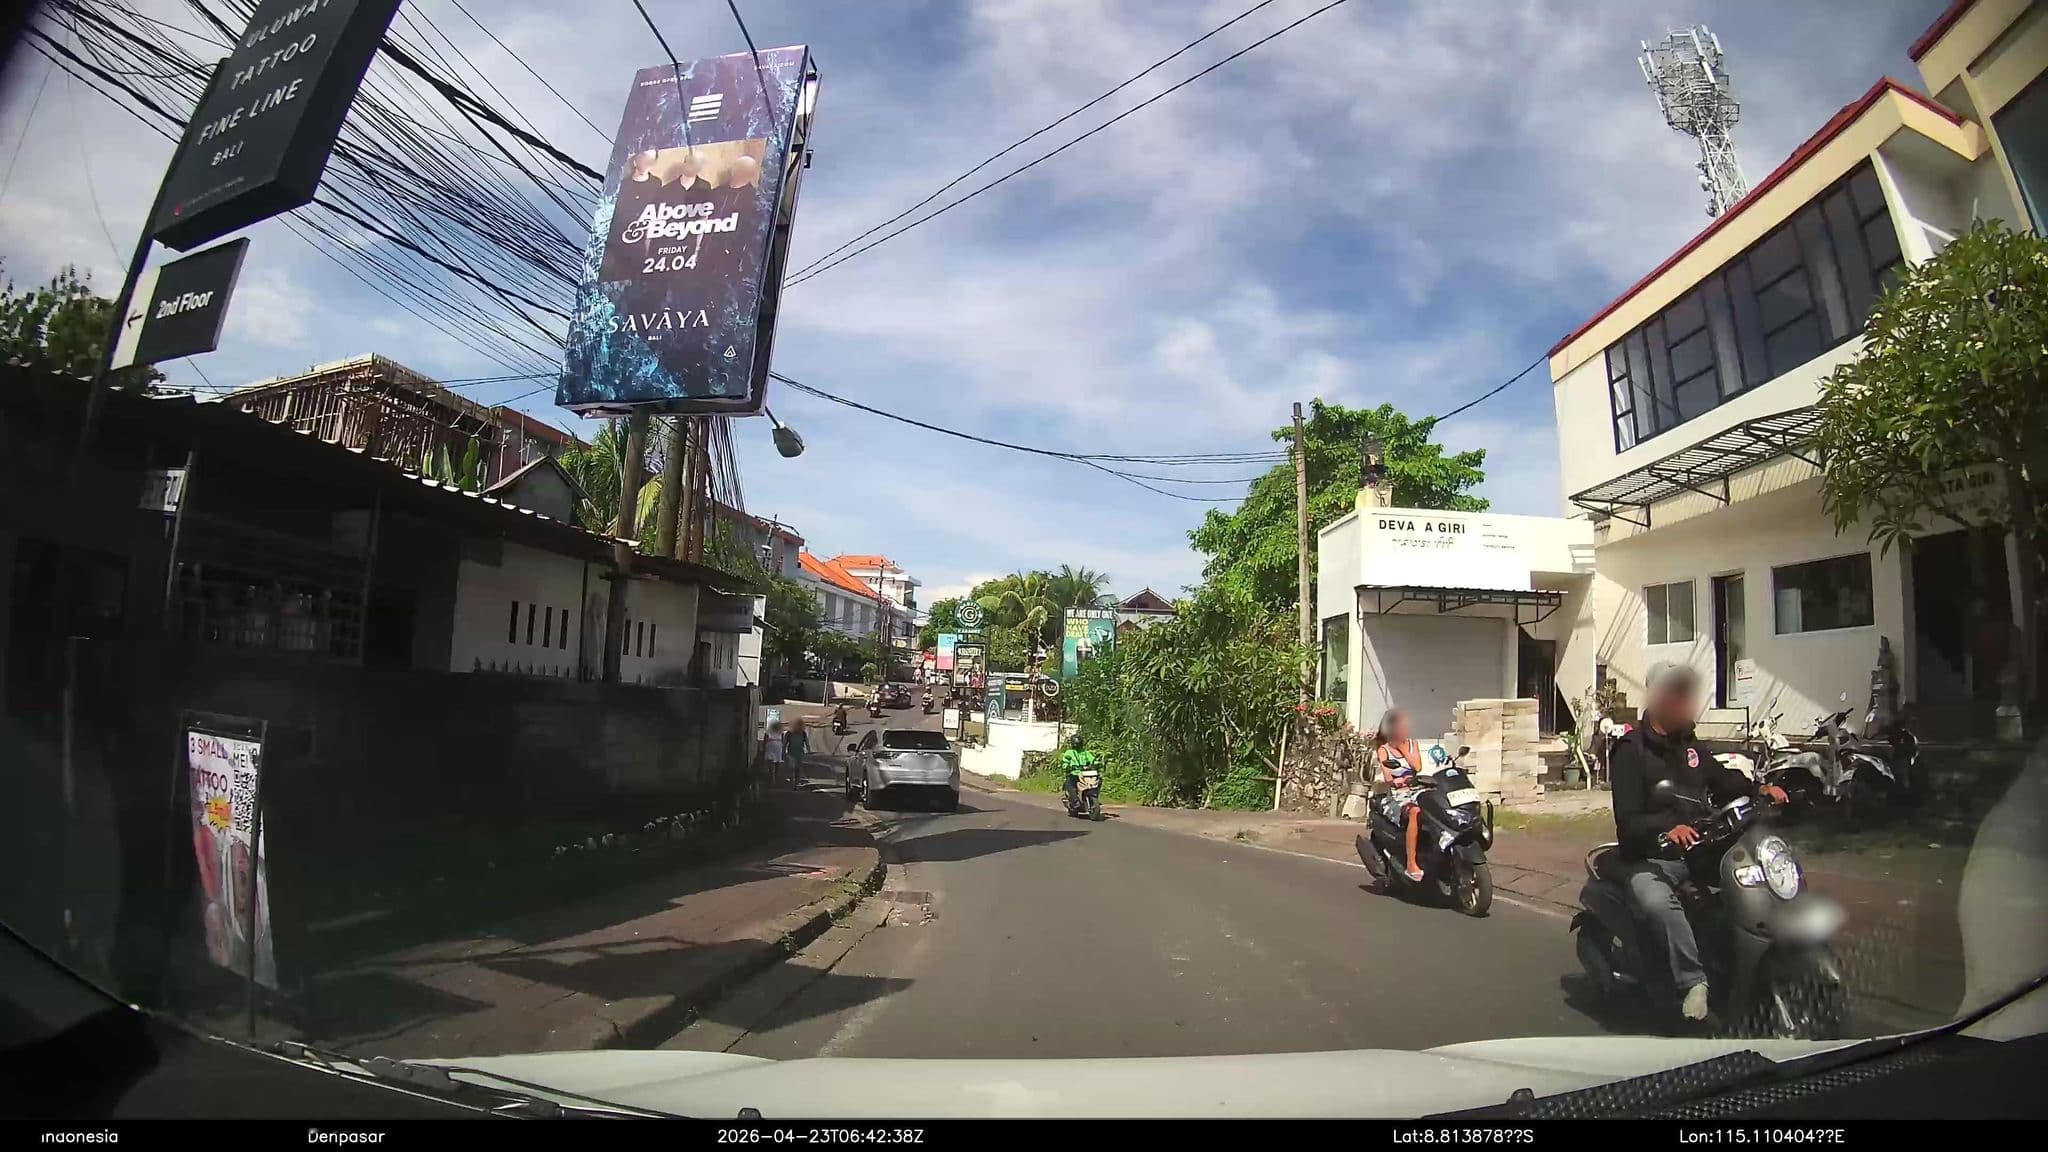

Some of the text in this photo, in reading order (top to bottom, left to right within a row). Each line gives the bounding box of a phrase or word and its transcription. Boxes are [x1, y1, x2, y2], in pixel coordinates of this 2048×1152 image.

[246, 0, 329, 48] ULUWA
[230, 33, 317, 90] TATTOO
[198, 78, 303, 145] FINE LINE
[211, 141, 245, 167] BALI
[638, 200, 715, 223] Above
[622, 212, 739, 244] & Beyond
[658, 245, 688, 256] FRIDAY
[642, 256, 698, 274] 24.04
[155, 289, 214, 320] 2nd Floor
[1379, 519, 1465, 534] DEVA A GIRI
[190, 737, 195, 753] 3
[197, 738, 229, 760] SMALL
[190, 765, 228, 793] TATTOO
